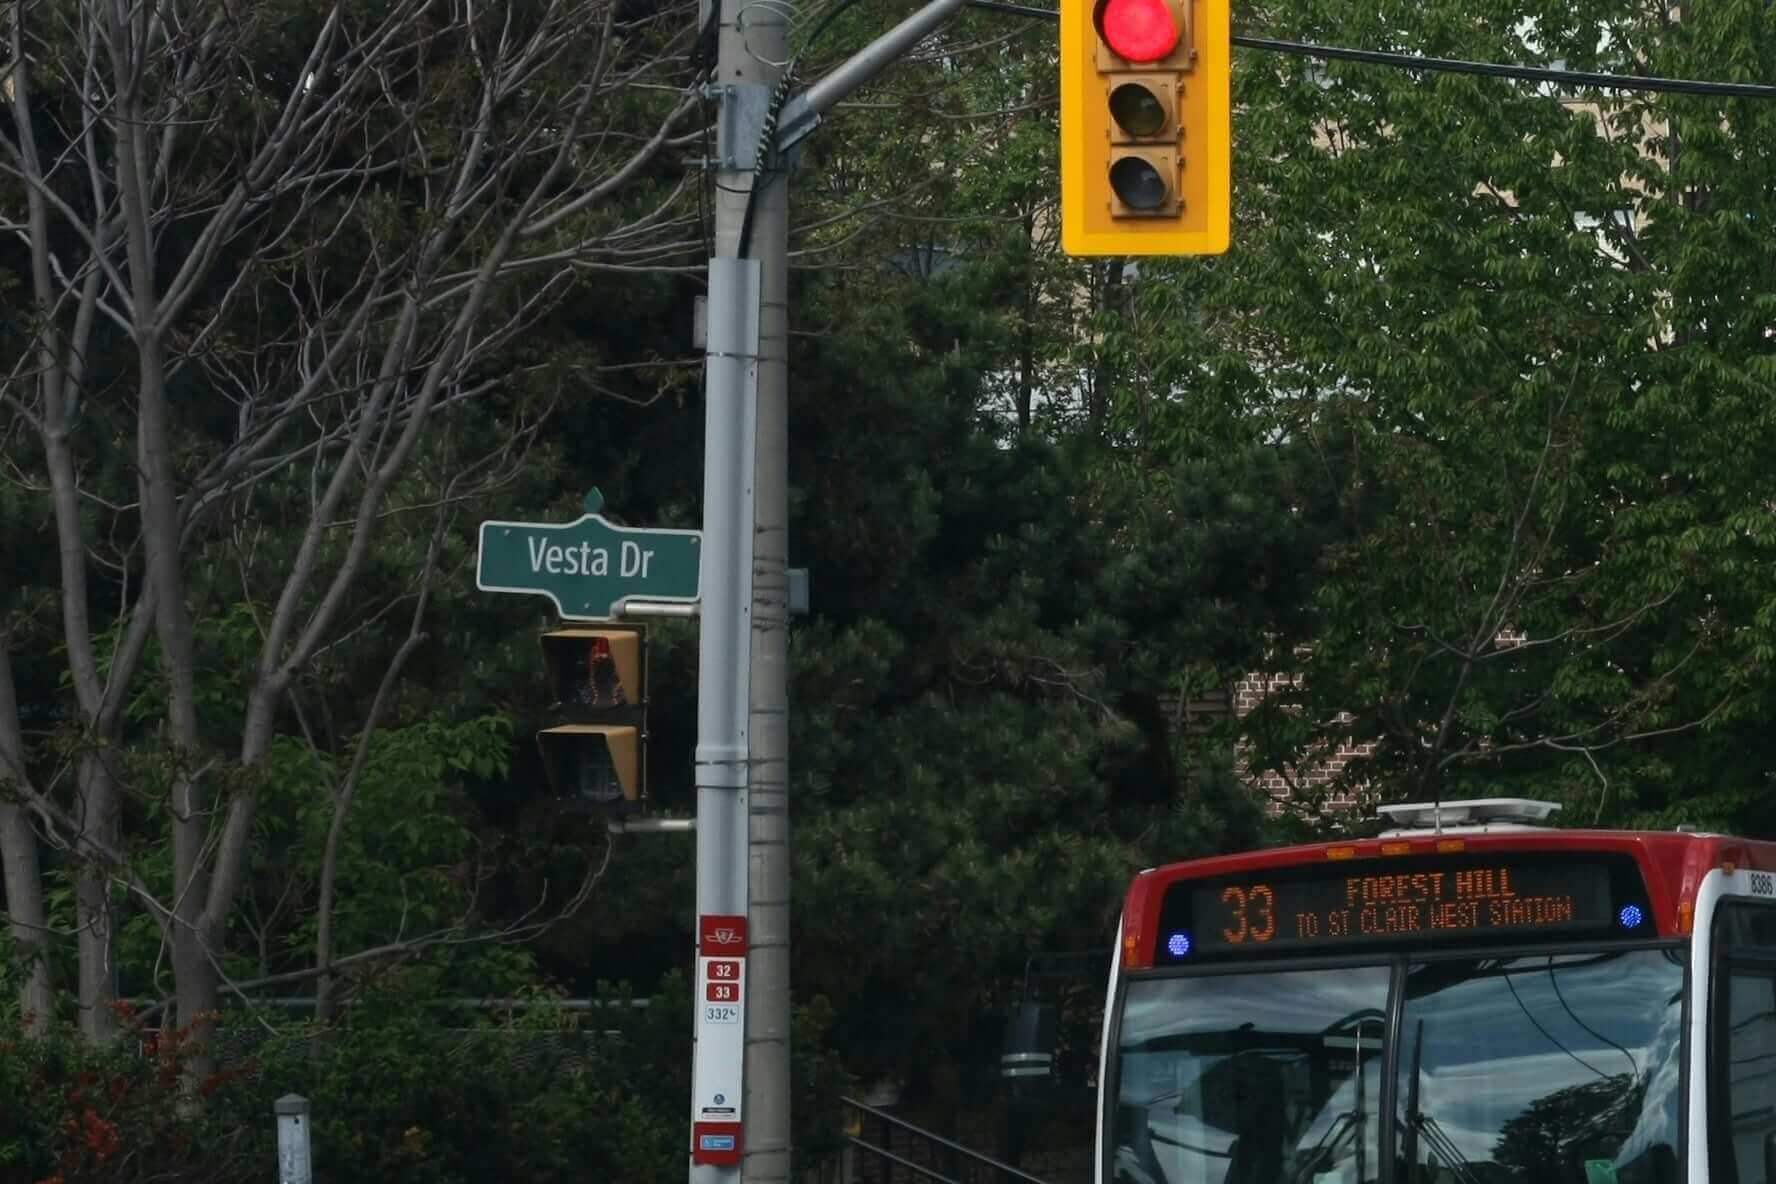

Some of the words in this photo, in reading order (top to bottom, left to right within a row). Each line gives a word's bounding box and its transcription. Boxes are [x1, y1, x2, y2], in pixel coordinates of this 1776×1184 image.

[527, 535, 609, 577] Vesta
[619, 540, 655, 578] Dr
[1346, 872, 1445, 907] FOREST
[1455, 868, 1516, 900] HILL
[1750, 872, 1774, 895] 8386
[1221, 884, 1276, 944] 33
[1296, 912, 1319, 938] TO
[1328, 910, 1350, 937] ST
[1360, 904, 1421, 934] CLAIR
[1430, 901, 1479, 929] WEST
[1489, 895, 1573, 927] STATION
[715, 964, 731, 977] 32
[715, 986, 731, 999] 33
[707, 1007, 729, 1020] 332
